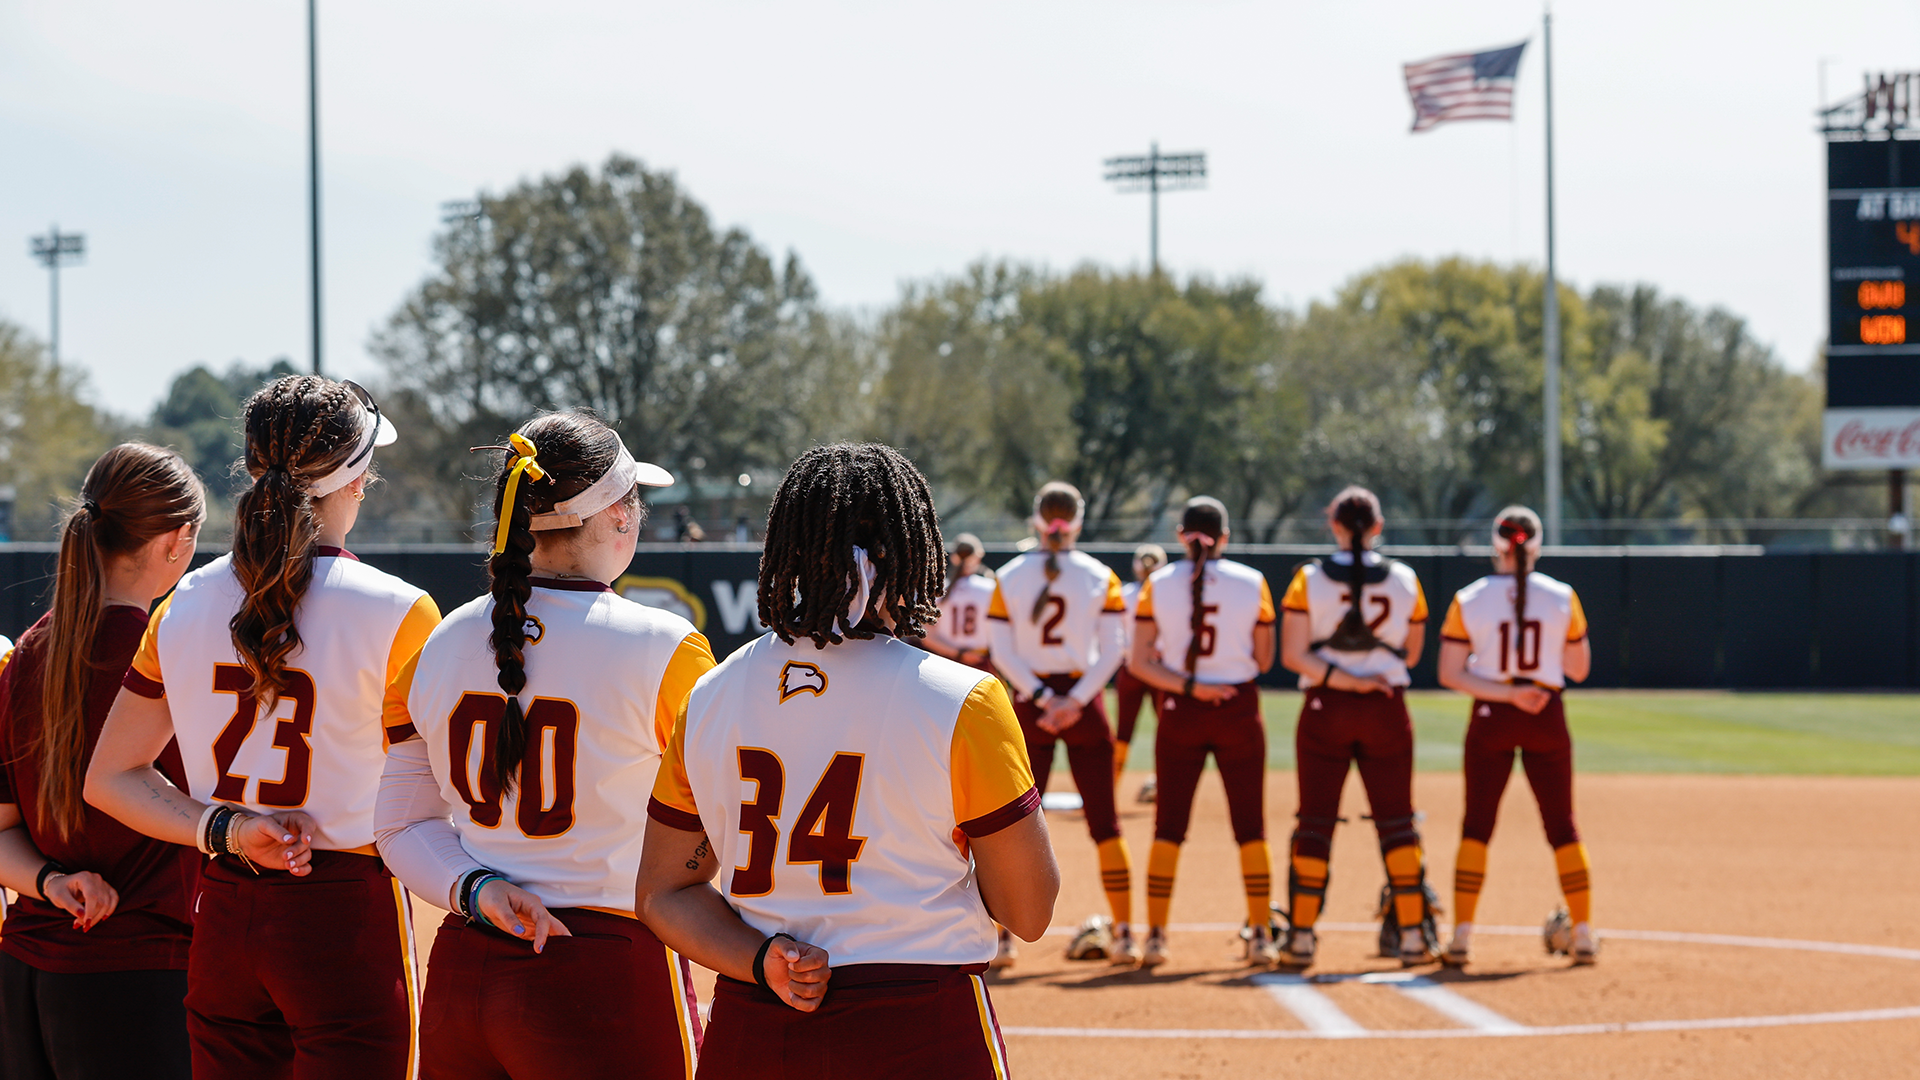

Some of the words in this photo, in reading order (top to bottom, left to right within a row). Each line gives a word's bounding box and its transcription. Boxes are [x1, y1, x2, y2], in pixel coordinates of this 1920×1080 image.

[952, 604, 977, 637] 18
[1041, 595, 1067, 646] 2
[1498, 619, 1542, 673] 10
[211, 661, 317, 810] 23
[447, 690, 580, 840] 00
[730, 745, 869, 899] 34
